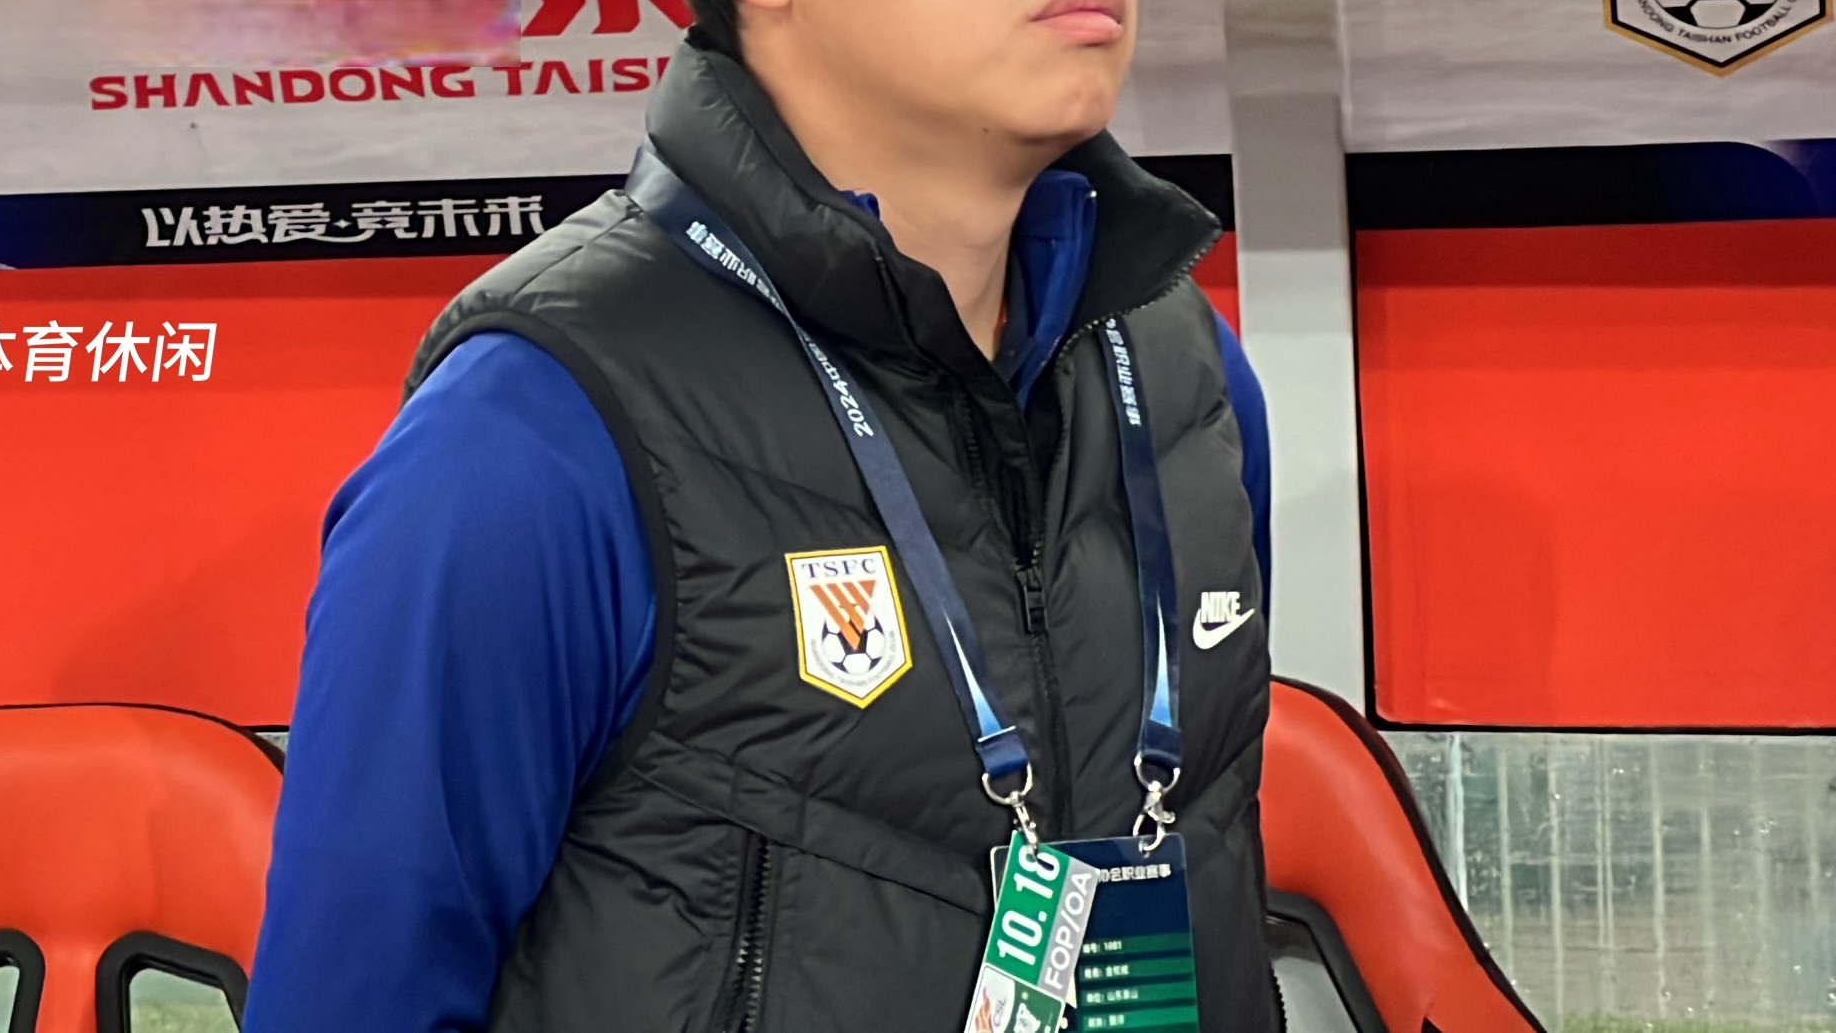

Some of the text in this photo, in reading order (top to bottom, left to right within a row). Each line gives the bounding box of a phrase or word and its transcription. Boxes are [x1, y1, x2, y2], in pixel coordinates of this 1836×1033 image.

[1676, 27, 1733, 44] TAISHAN
[1735, 6, 1791, 42] FOOTBALL
[89, 65, 477, 111] SHANDONG
[801, 558, 877, 580] TSFC
[1200, 591, 1241, 623] NIKE
[996, 844, 1061, 966] 10.18
[1044, 872, 1093, 990] FOP/OA
